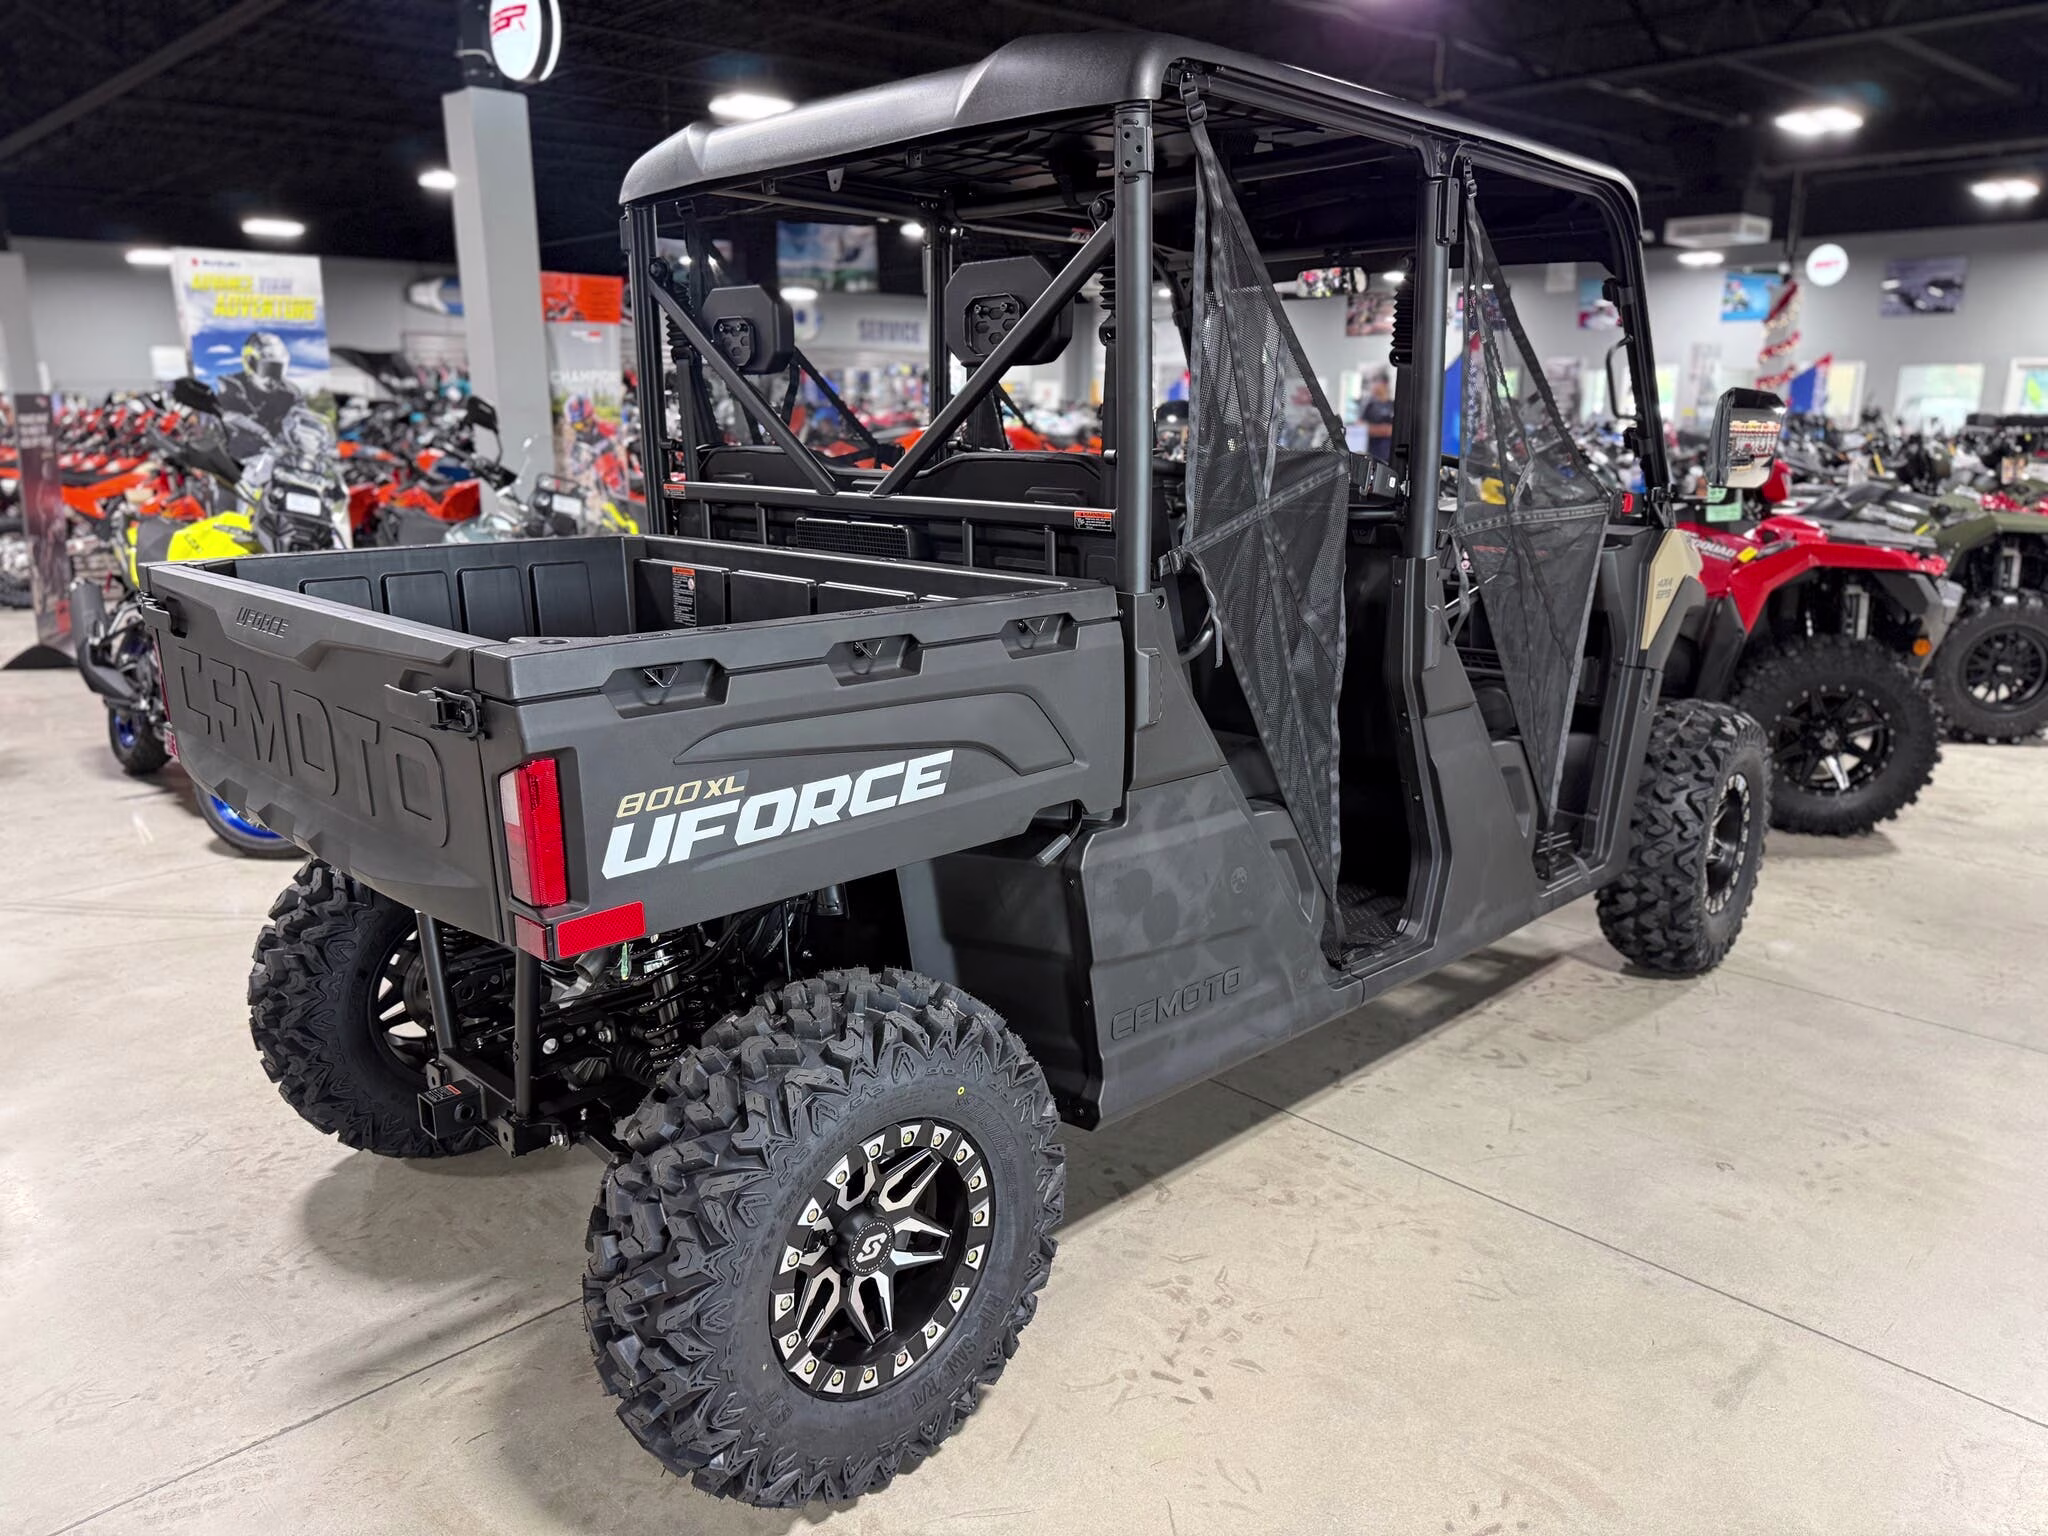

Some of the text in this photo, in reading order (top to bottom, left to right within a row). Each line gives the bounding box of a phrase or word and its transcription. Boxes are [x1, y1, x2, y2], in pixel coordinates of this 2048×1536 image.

[214, 294, 318, 321] ADVENTURE
[858, 317, 921, 343] SERVICE
[236, 606, 289, 639] UFORCE
[178, 645, 449, 849] CFMOTO
[601, 749, 954, 880] UFORCE
[616, 775, 746, 819] 800XL
[1111, 965, 1241, 1040] CFMOTO
